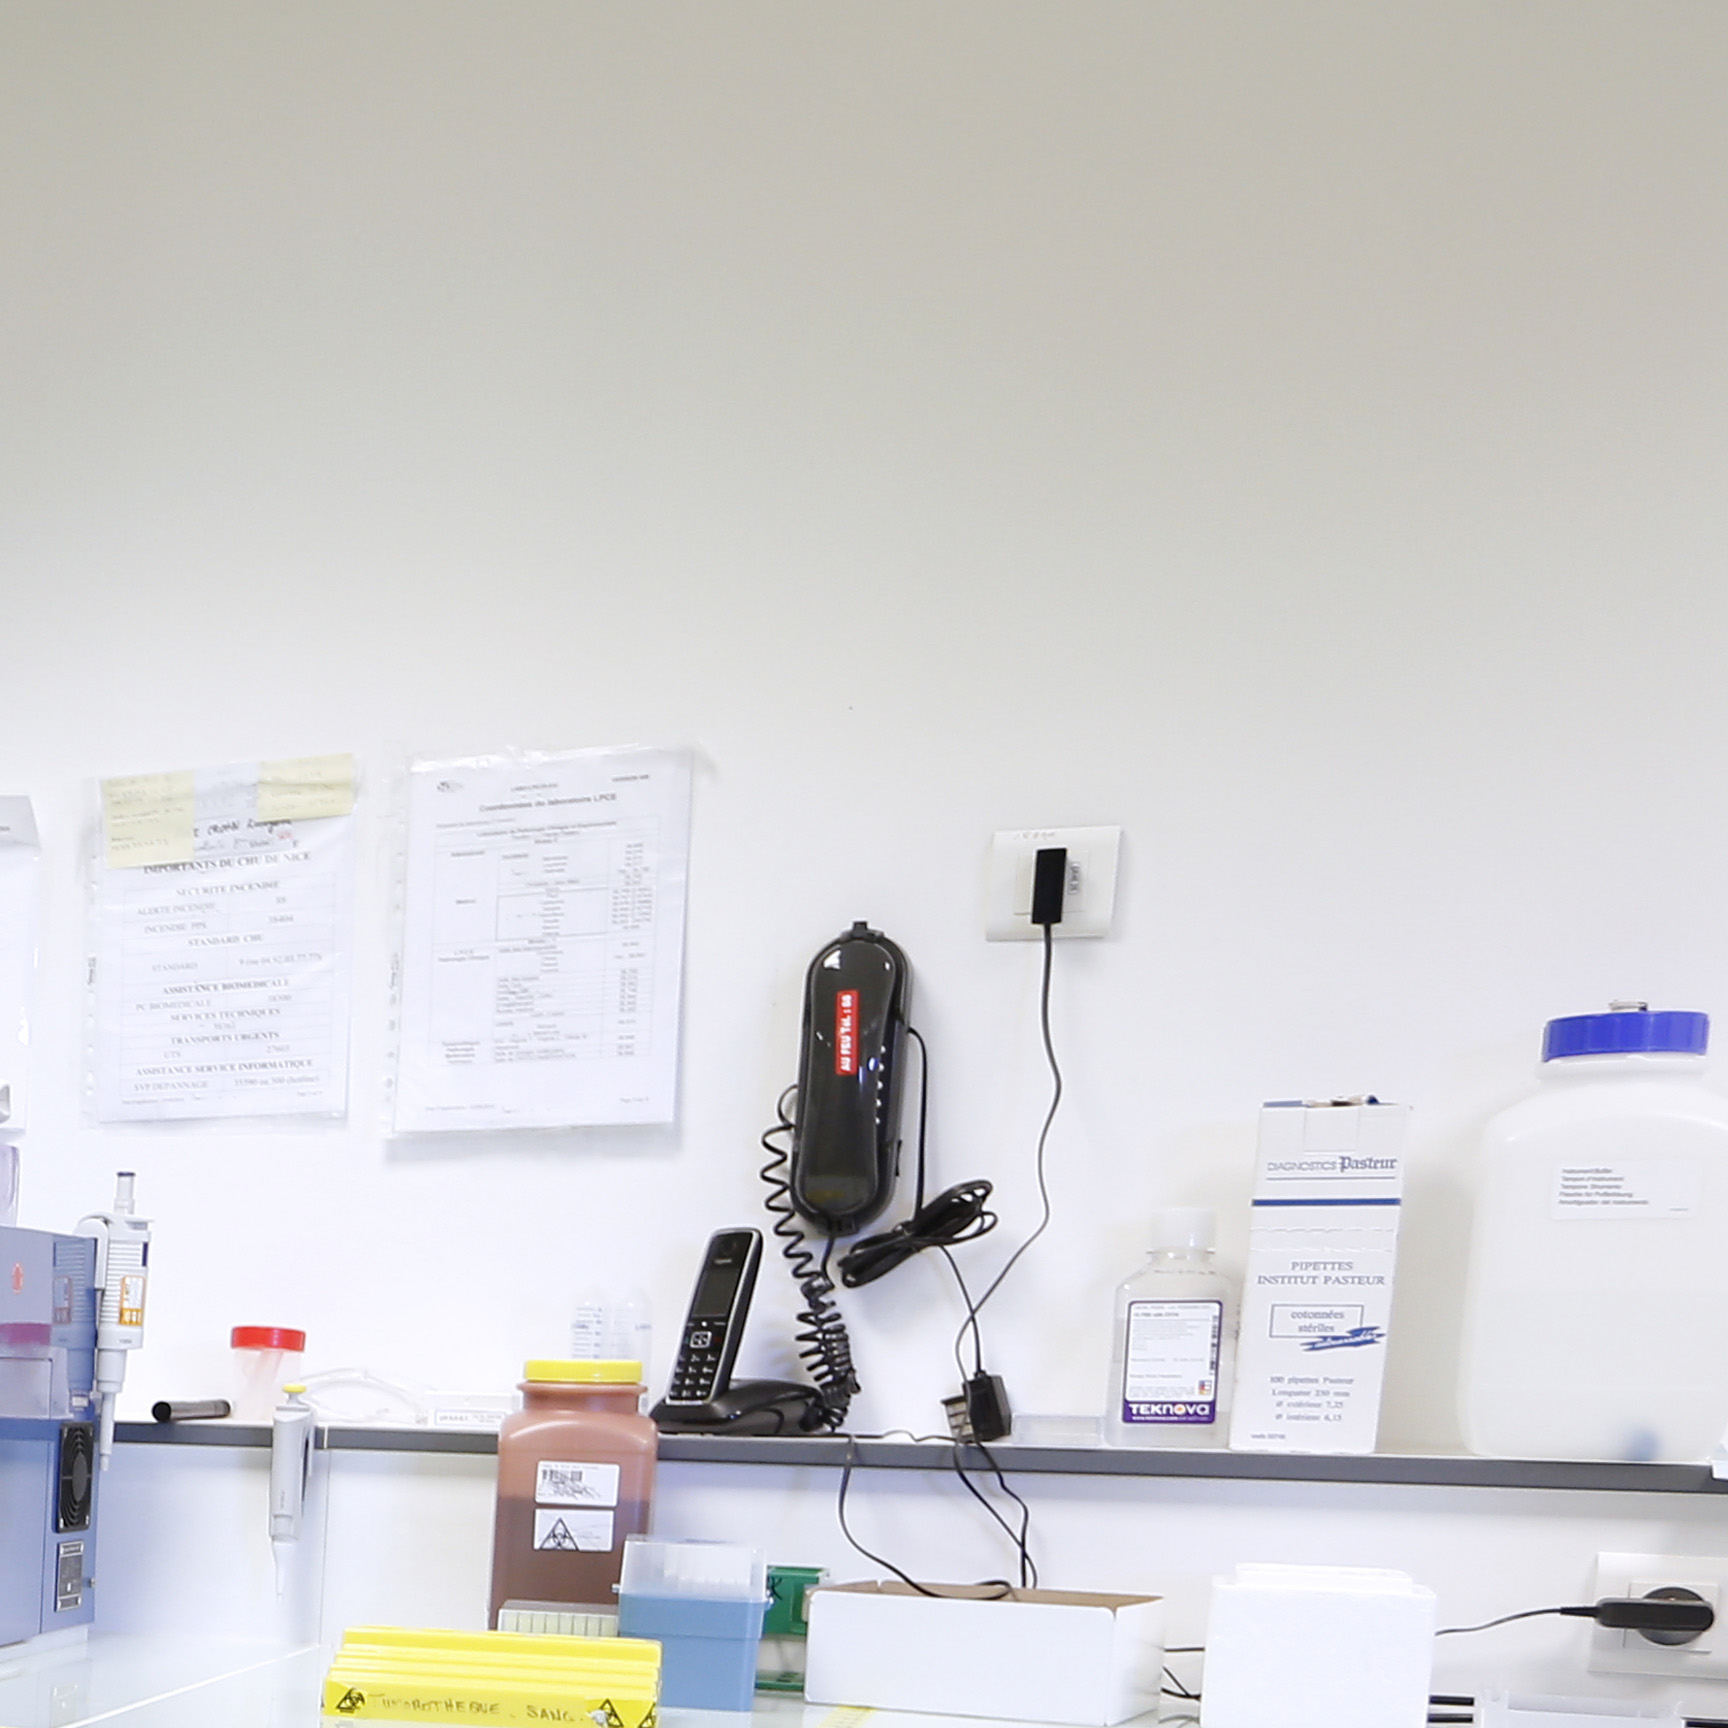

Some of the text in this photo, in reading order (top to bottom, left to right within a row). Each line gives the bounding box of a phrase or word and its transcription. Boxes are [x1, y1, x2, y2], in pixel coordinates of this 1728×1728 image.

[219, 858, 232, 868] DU
[237, 856, 260, 866] CHU
[282, 852, 312, 862] NICE
[840, 1035, 852, 1055] FEU
[238, 1059, 313, 1072] INFORMATIQUE
[1267, 1155, 1398, 1173] DIAGNOSTICS Pasteur
[1291, 1261, 1353, 1271] PIPETTES
[1257, 1275, 1386, 1286] INSTITUT PASTEUR
[1290, 1310, 1344, 1320] cotonnées
[1298, 1323, 1335, 1333] stériles
[1287, 1376, 1319, 1385] pipettes
